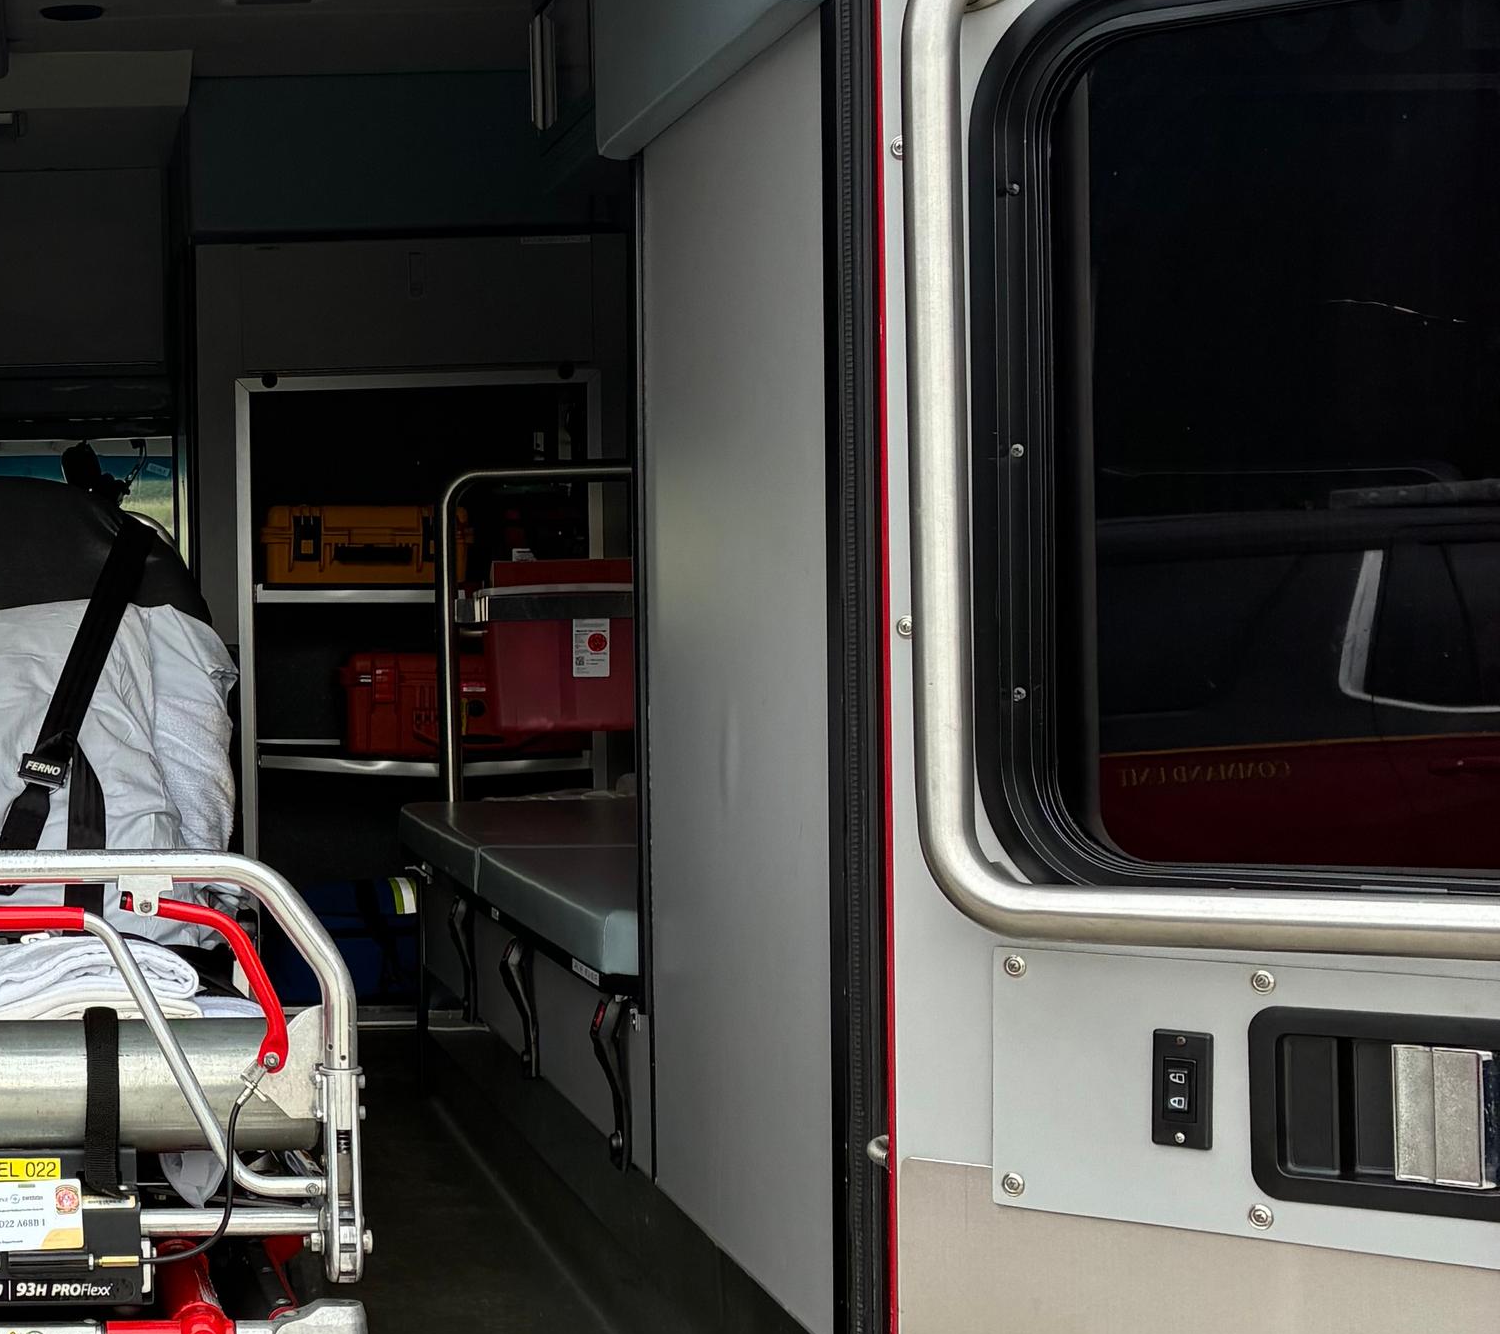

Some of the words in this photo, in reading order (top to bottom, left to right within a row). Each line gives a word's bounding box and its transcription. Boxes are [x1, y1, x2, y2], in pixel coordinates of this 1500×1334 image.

[25, 760, 61, 776] FERNO
[25, 1161, 57, 1178] 022
[16, 1282, 47, 1297] 93H
[51, 1283, 110, 1297] PROFlexx
